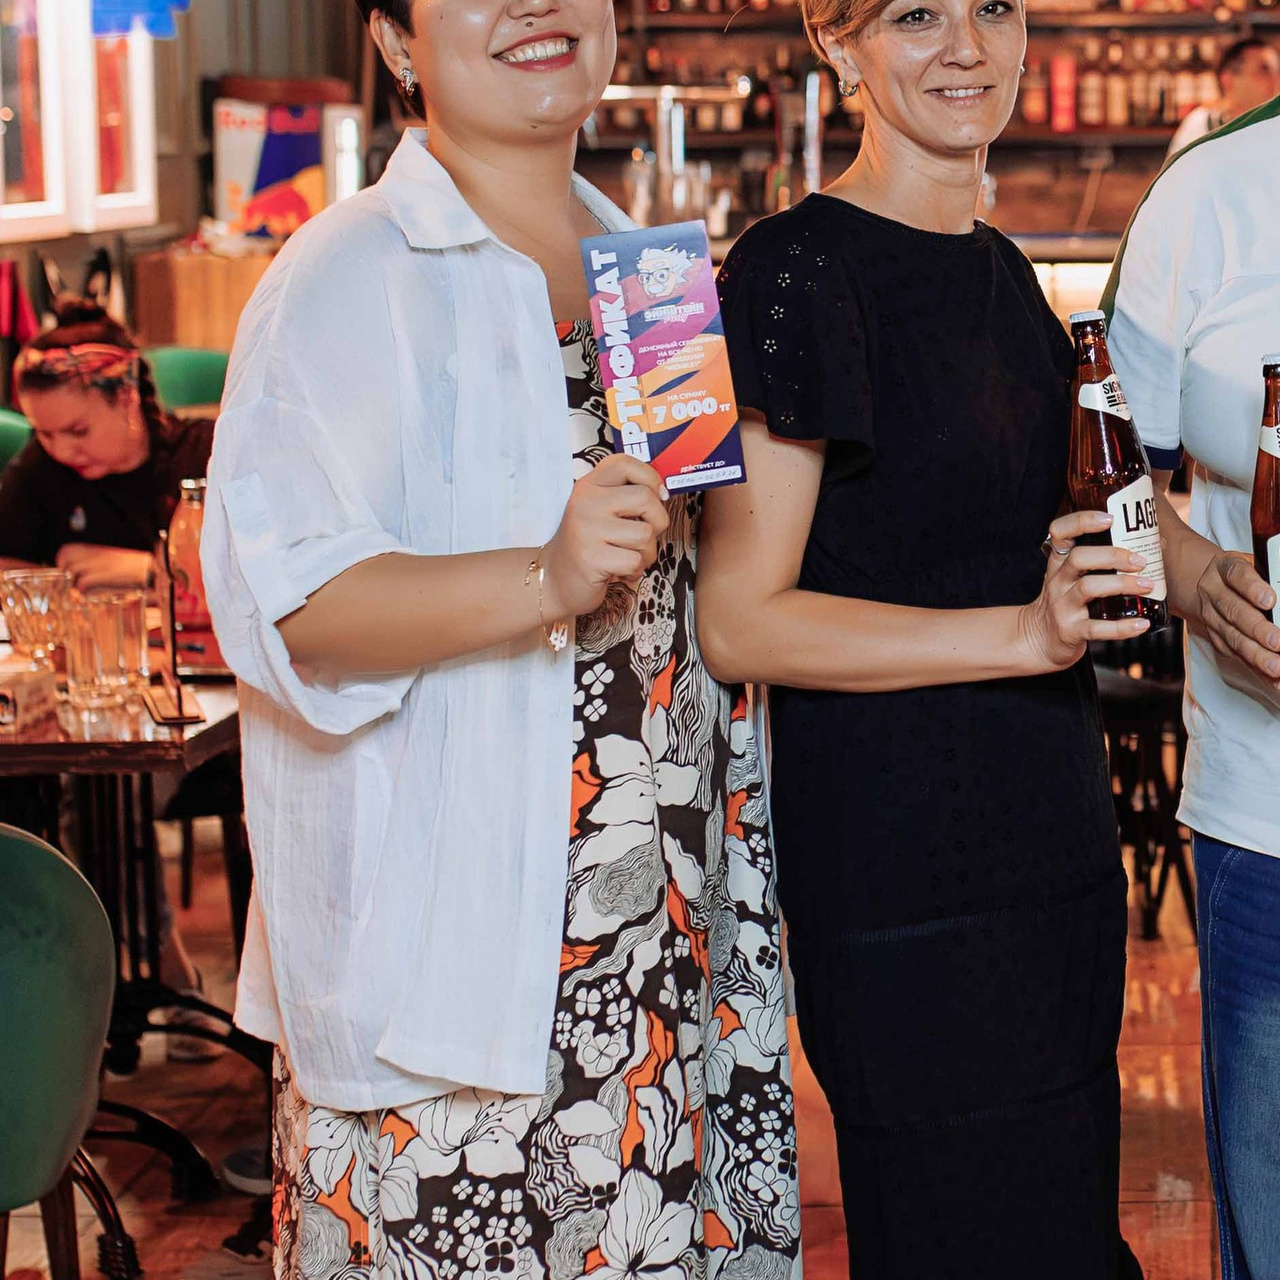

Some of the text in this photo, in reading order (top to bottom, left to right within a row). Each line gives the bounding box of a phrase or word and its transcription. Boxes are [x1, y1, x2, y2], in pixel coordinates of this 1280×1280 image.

[590, 248, 652, 463] ЕРТИФИКАТ
[652, 404, 667, 425] 7
[671, 396, 718, 421] 000
